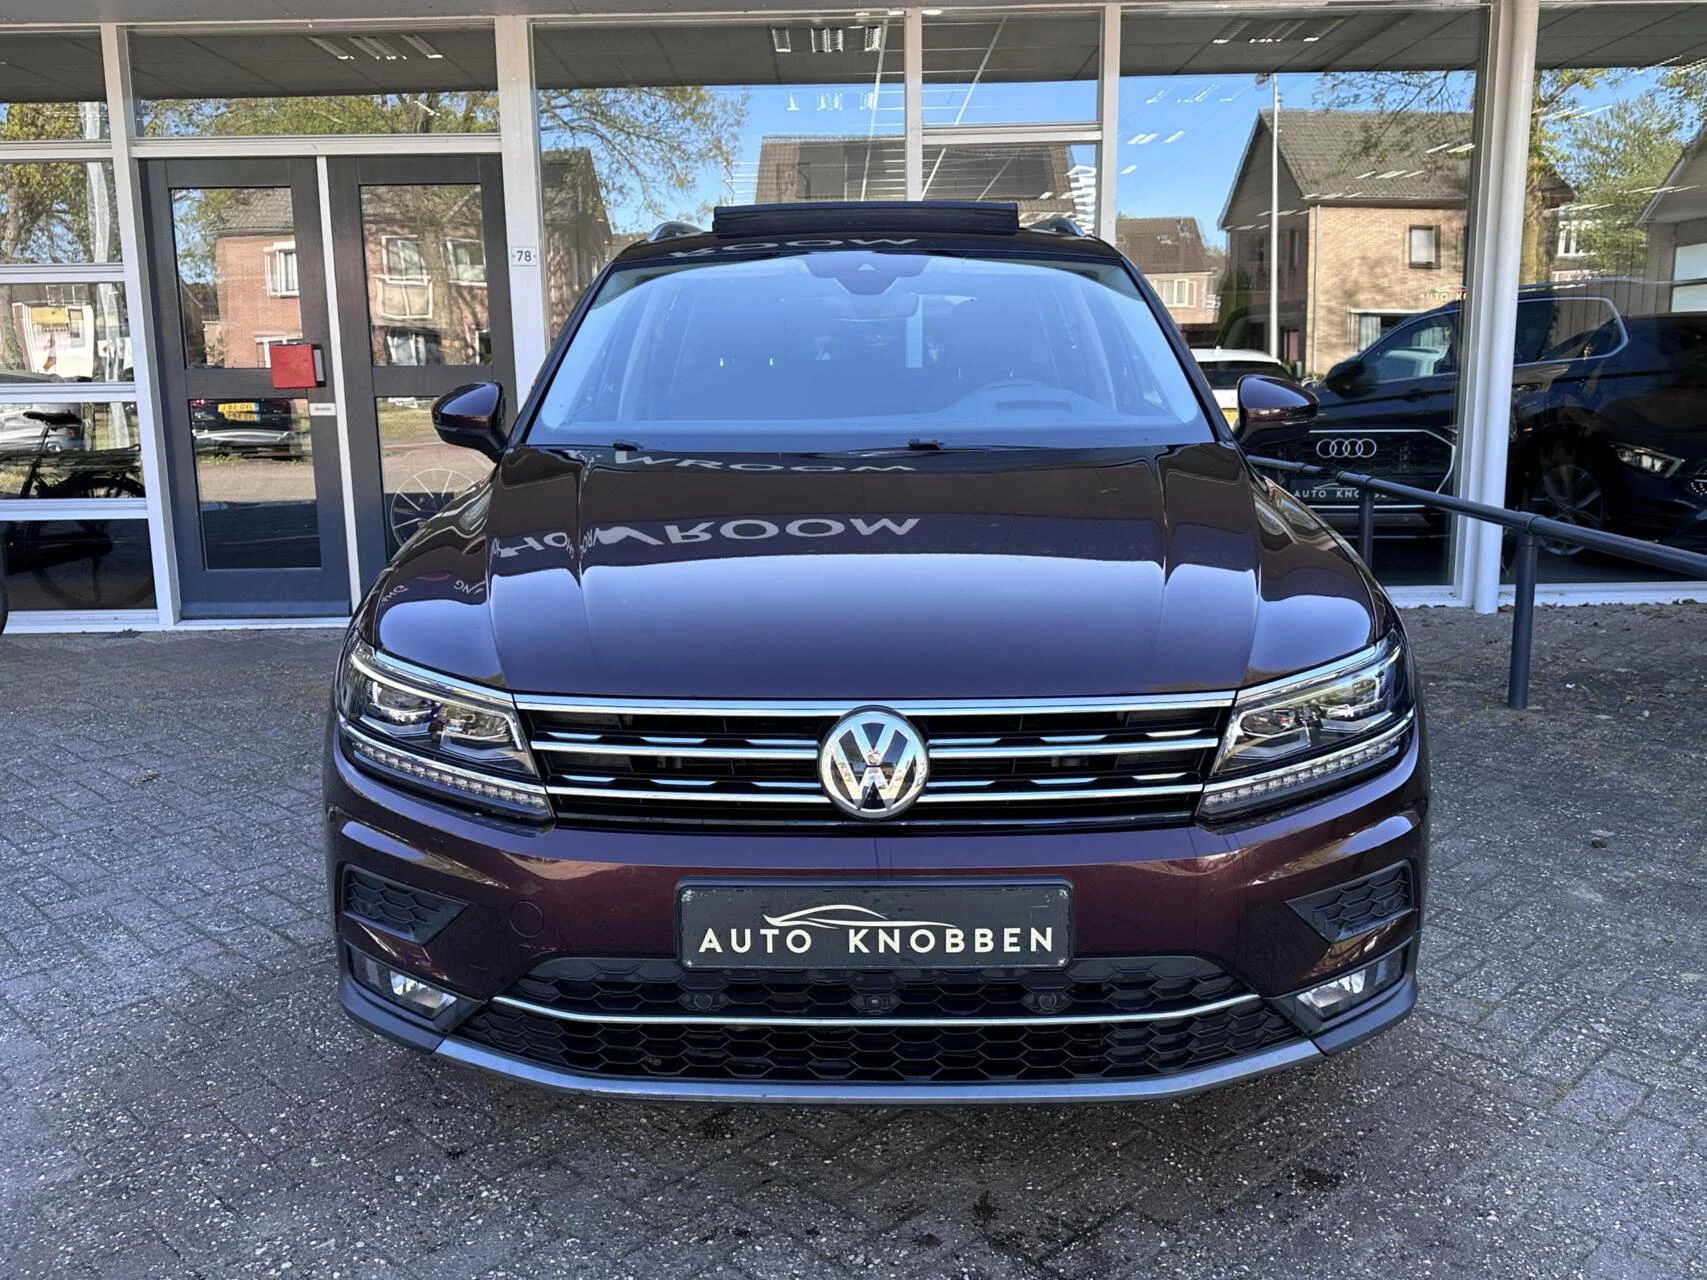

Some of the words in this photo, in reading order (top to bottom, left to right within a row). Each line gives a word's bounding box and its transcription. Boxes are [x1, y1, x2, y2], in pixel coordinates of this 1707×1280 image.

[516, 250, 532, 262] 78
[1294, 489, 1327, 498] AUTO
[698, 927, 812, 954] AUTO
[848, 927, 1053, 954] KNOBBEN
